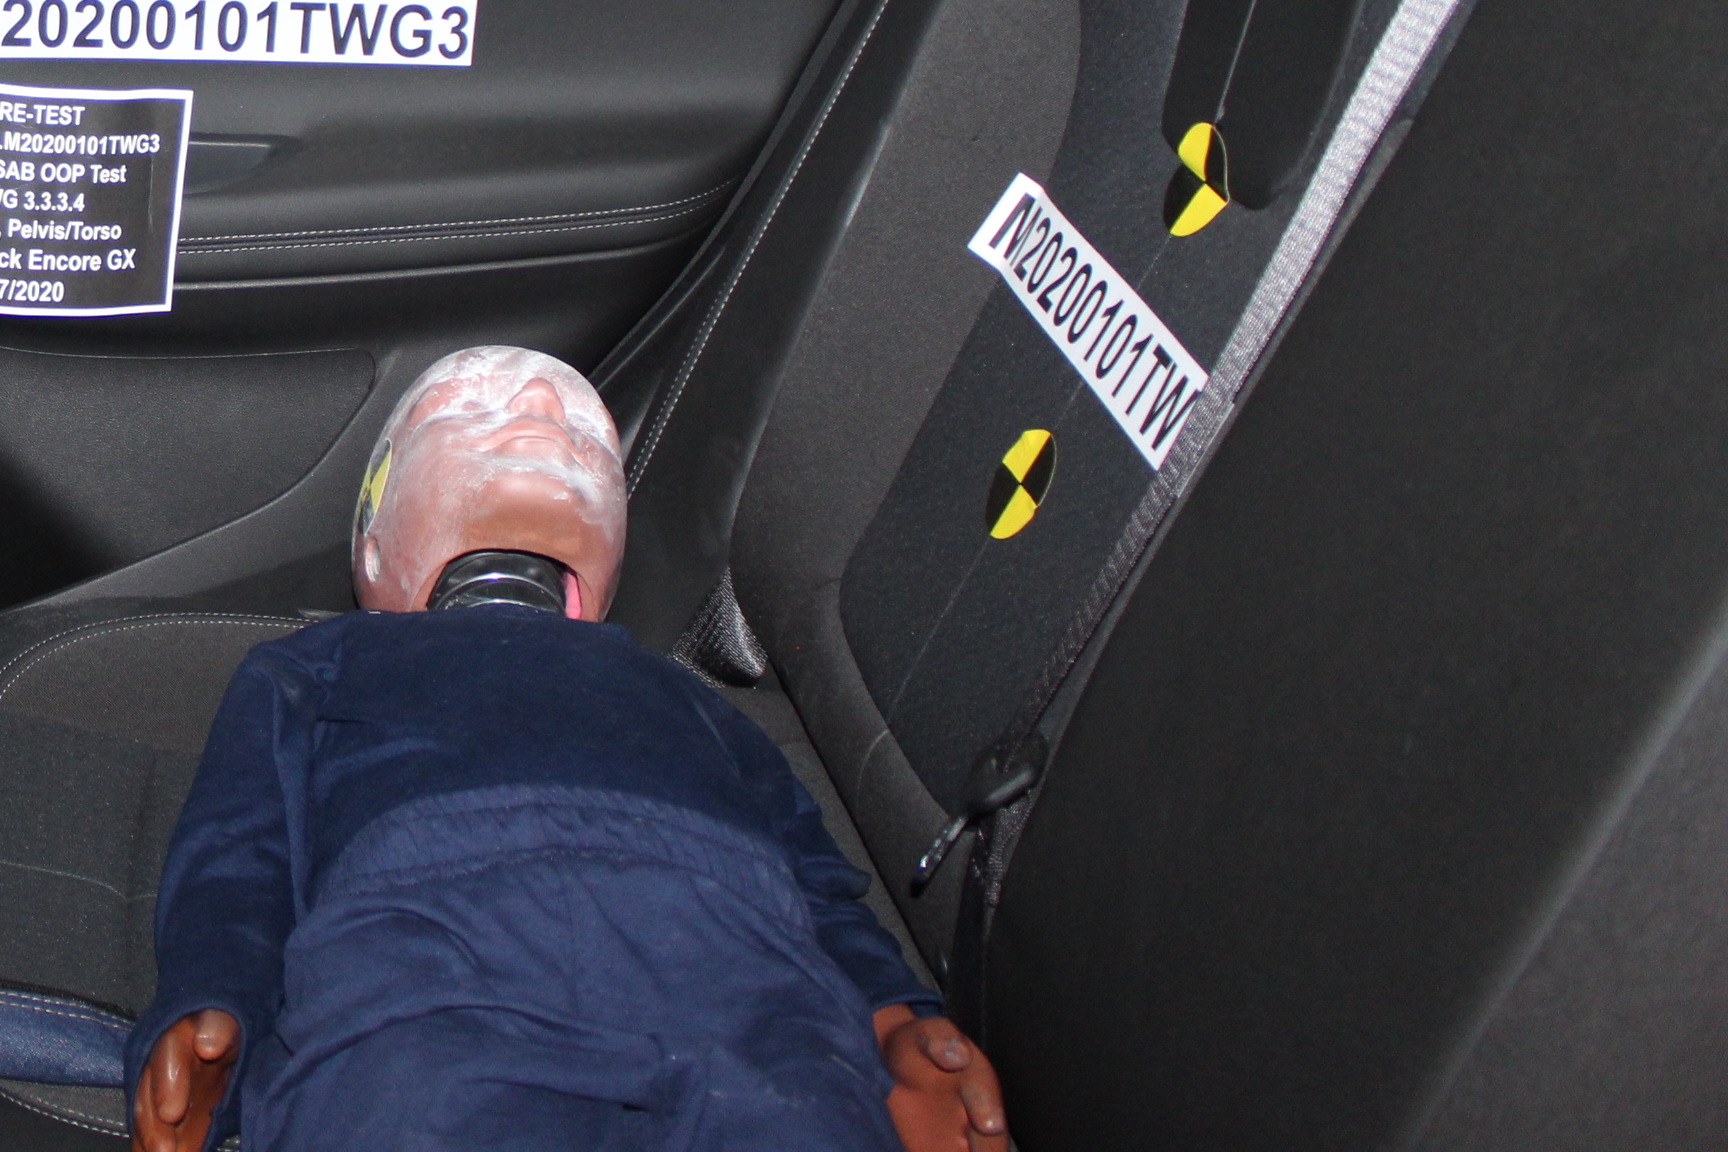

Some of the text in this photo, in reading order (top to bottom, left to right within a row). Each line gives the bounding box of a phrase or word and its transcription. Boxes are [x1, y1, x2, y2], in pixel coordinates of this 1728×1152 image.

[41, 163, 85, 183] OOP
[90, 164, 127, 183] Test
[23, 191, 85, 212] 3.3.3.4
[8, 218, 122, 241] Pelvis/Torso
[28, 249, 102, 271] Encore
[107, 248, 136, 270] GX
[988, 192, 1203, 452] M20200101TW
